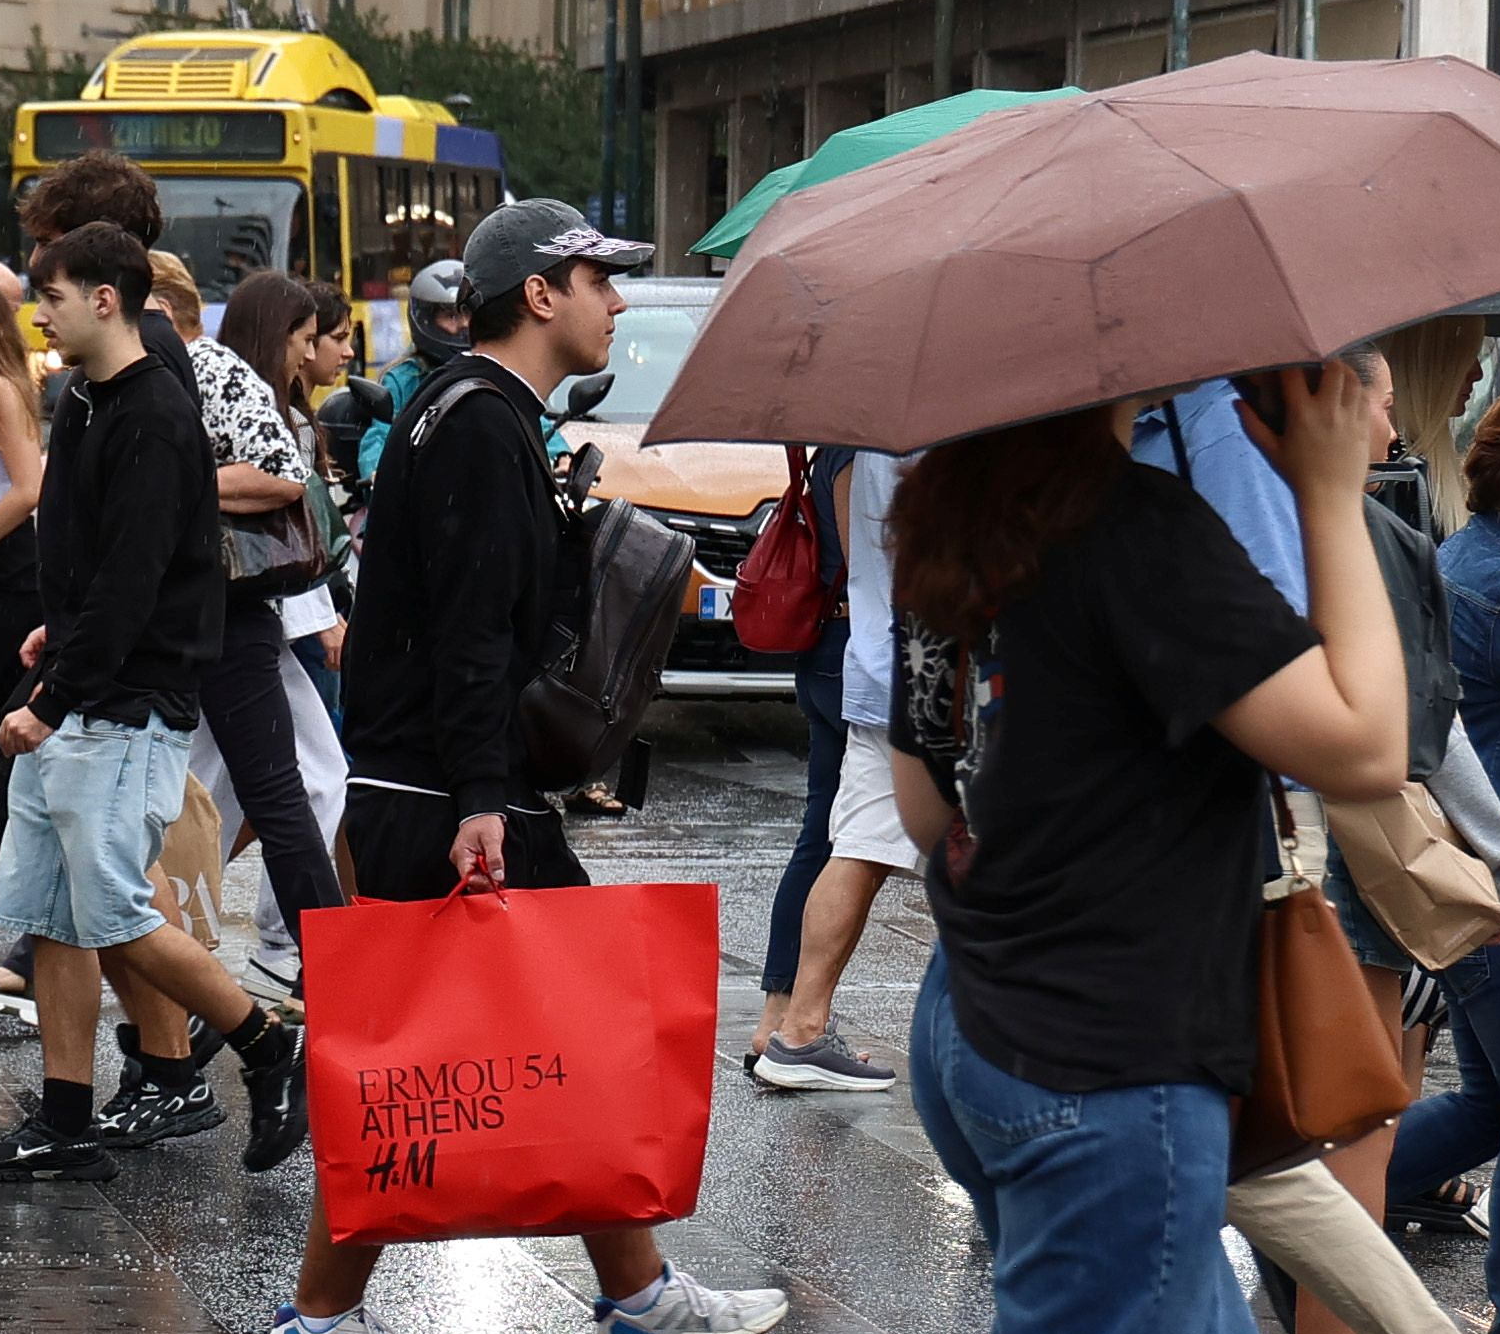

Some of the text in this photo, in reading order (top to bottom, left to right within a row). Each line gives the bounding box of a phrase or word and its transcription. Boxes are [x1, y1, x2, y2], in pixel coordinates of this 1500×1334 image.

[358, 1052, 567, 1106] ERMOU 54
[360, 1095, 505, 1141] ATHENS
[365, 1138, 438, 1194] H&M
